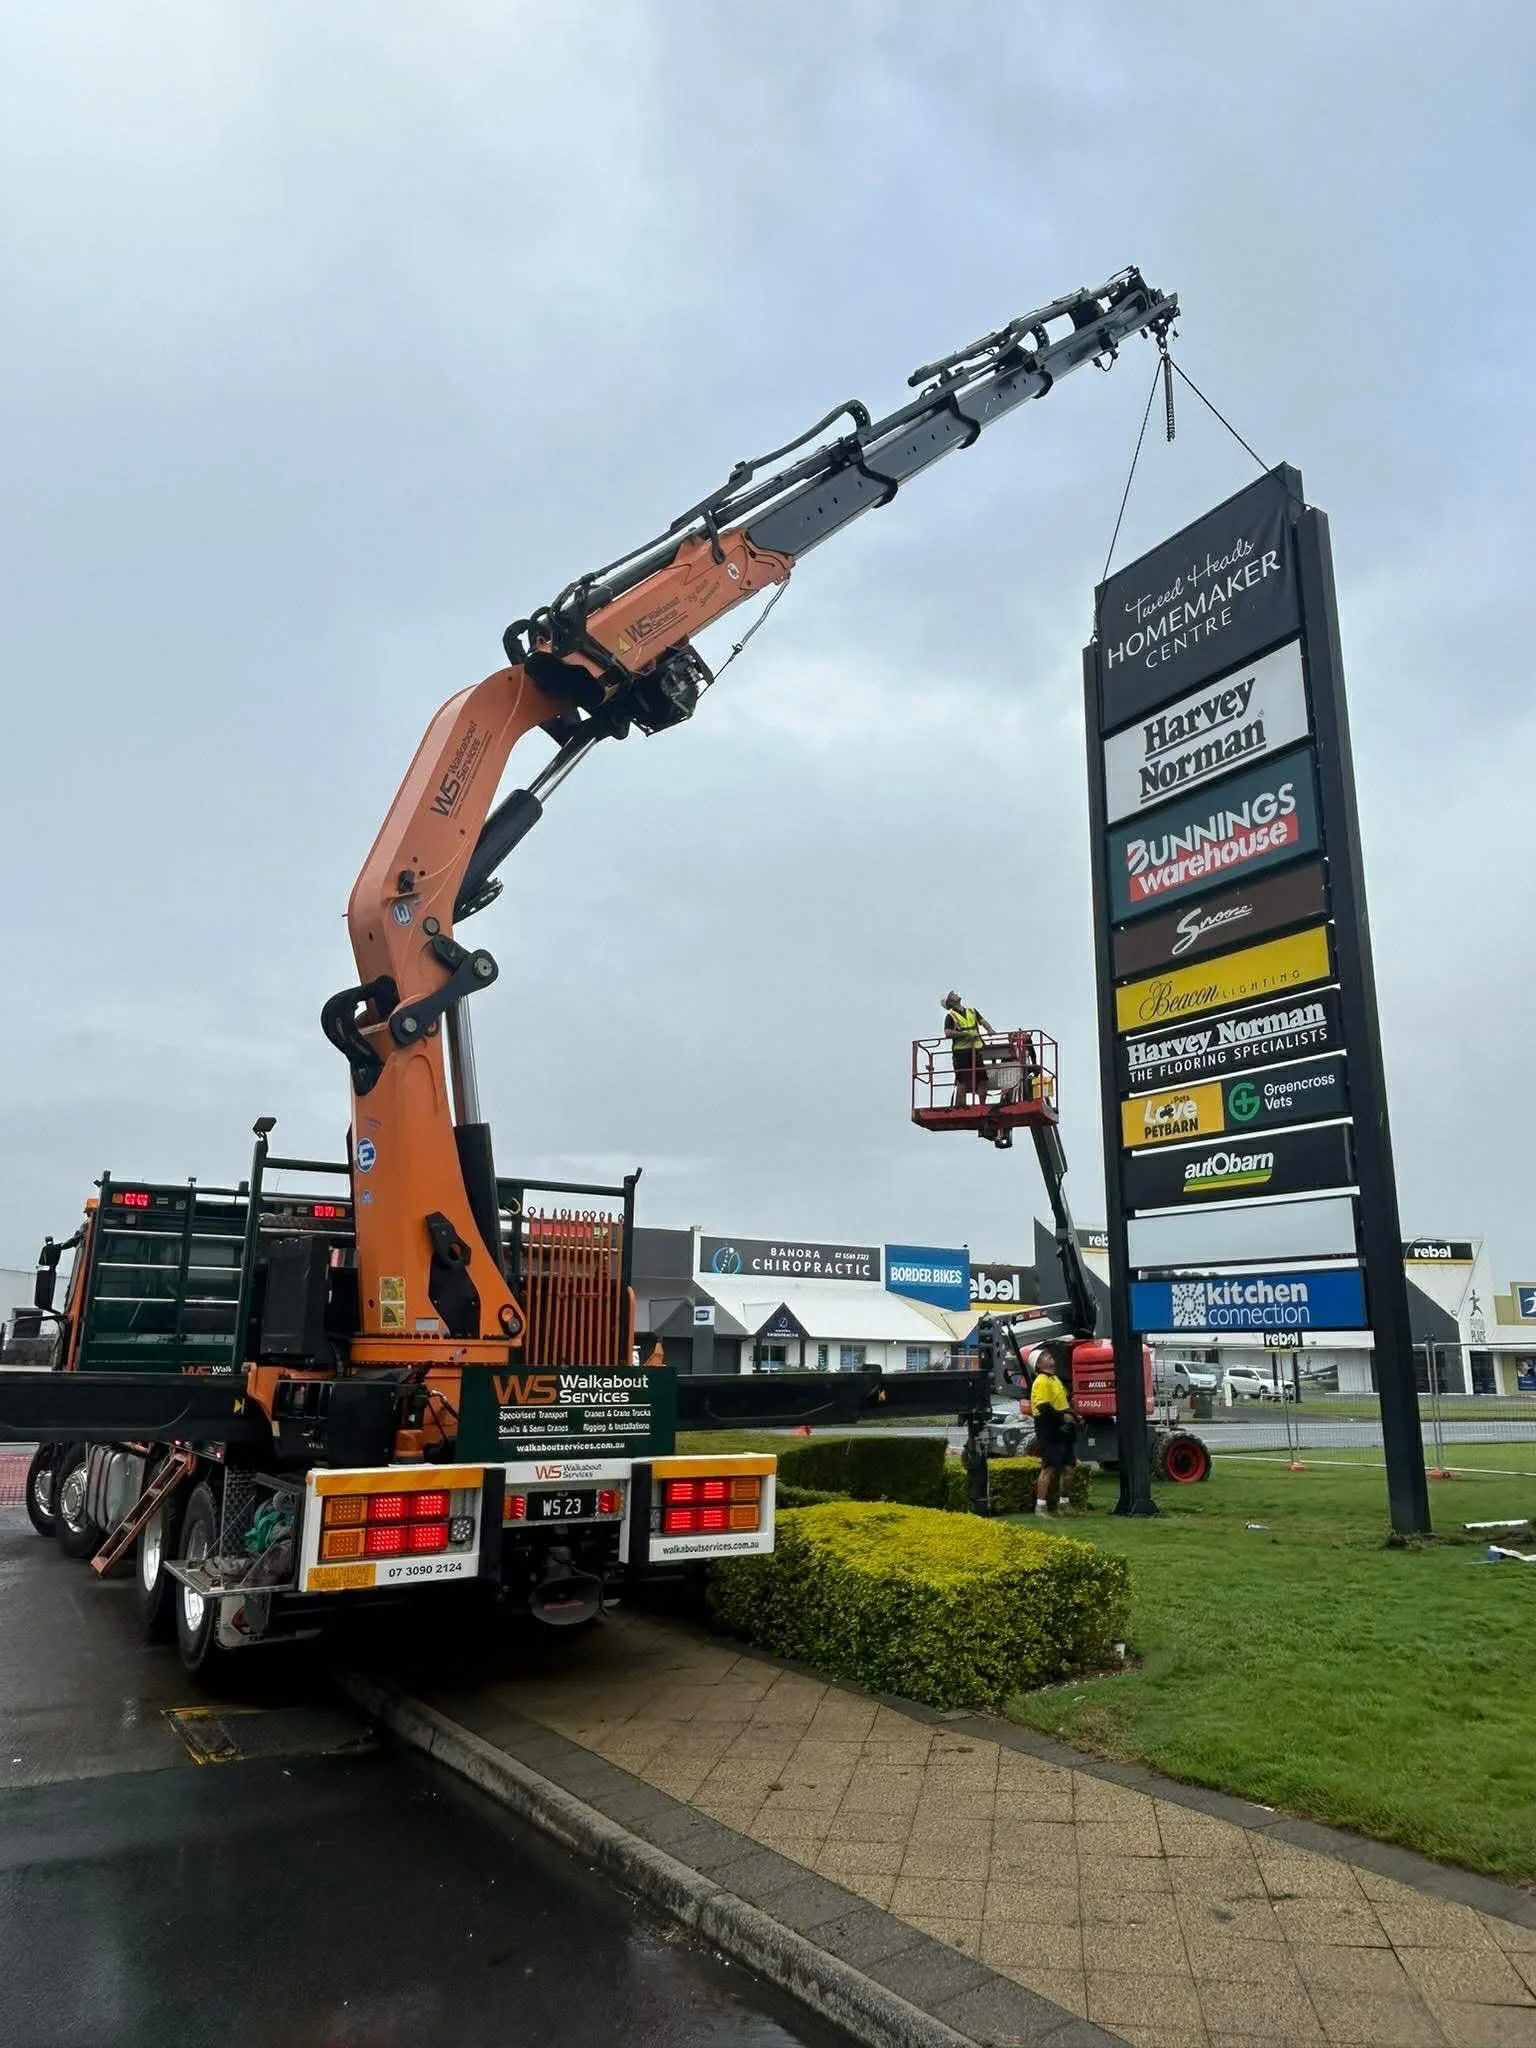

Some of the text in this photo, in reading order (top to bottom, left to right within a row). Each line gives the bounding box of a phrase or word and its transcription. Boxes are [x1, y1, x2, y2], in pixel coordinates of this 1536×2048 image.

[1125, 538, 1254, 624] Tweed Heads
[1108, 550, 1280, 668] HOMEMAKER
[1146, 607, 1232, 669] CENTRE
[1143, 678, 1256, 755] Harvey
[1139, 719, 1266, 797] Norman
[1127, 783, 1296, 876] BUNNINGS
[1139, 822, 1288, 895] warehouse
[1139, 970, 1300, 1021] Beacon LIGHTING
[1127, 1003, 1327, 1066] Harvey Norman
[1130, 1028, 1328, 1083] THE FLOORING SPECIALISTS
[1264, 1074, 1335, 1097] Greencross
[1265, 1096, 1293, 1111] Vets
[1144, 1118, 1199, 1139] PETBARN
[1089, 1234, 1109, 1247] reb
[771, 1247, 821, 1259] BANORA
[1414, 1245, 1452, 1258] rebel
[752, 1258, 871, 1276] CHIROPRACTIC
[891, 1267, 962, 1284] BORDER BIKES
[969, 1272, 1019, 1300] ebel
[1207, 1281, 1308, 1305] kitchen
[1208, 1304, 1310, 1325] connection
[492, 1375, 649, 1405] WS Walkabout
[560, 1390, 630, 1404] Services
[539, 1411, 568, 1420] Transport
[584, 1410, 605, 1418] Cranes
[517, 1442, 625, 1453] walkaboutservices.com.au
[535, 1465, 562, 1479] WS
[543, 1499, 581, 1516] WS 23
[662, 1541, 759, 1554] walkaboutservices.com.au
[389, 1563, 462, 1578] 07 3090 2124
